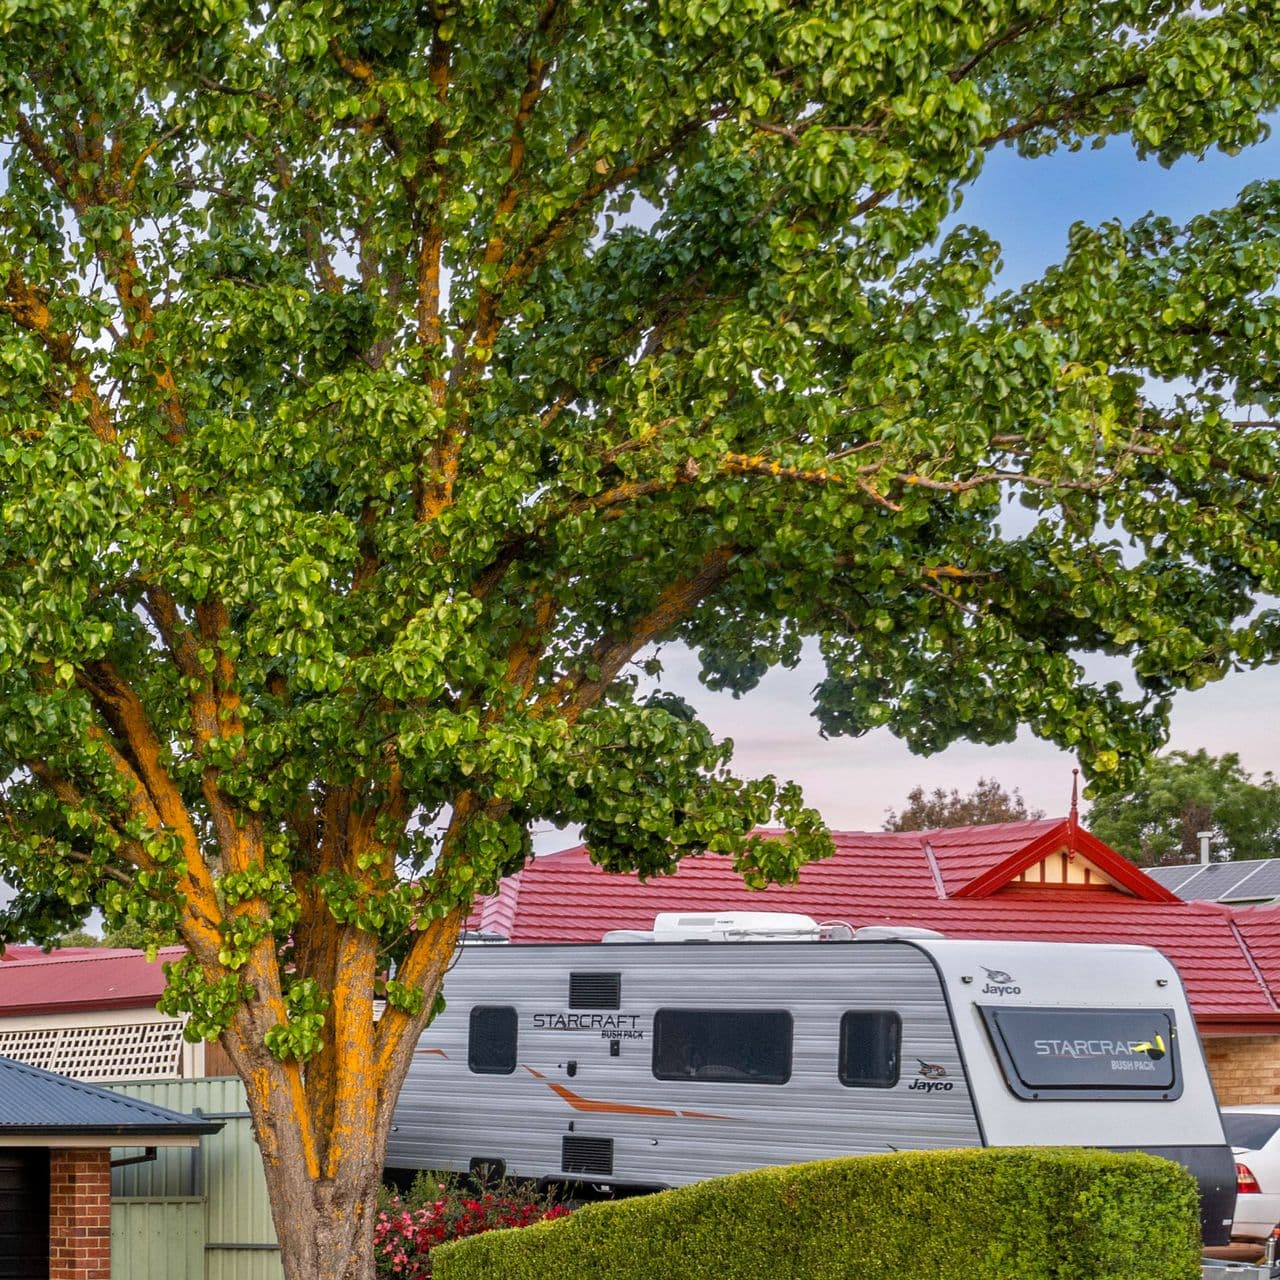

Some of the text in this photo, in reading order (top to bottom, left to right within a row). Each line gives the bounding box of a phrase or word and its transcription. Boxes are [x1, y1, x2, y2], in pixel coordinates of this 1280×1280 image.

[982, 983, 1021, 996] Jayco
[533, 1014, 640, 1029] STARCRAFT
[601, 1030, 644, 1040] BUSH PACK
[1111, 1060, 1156, 1071] BUSH PACK
[908, 1079, 953, 1093] Jayco
